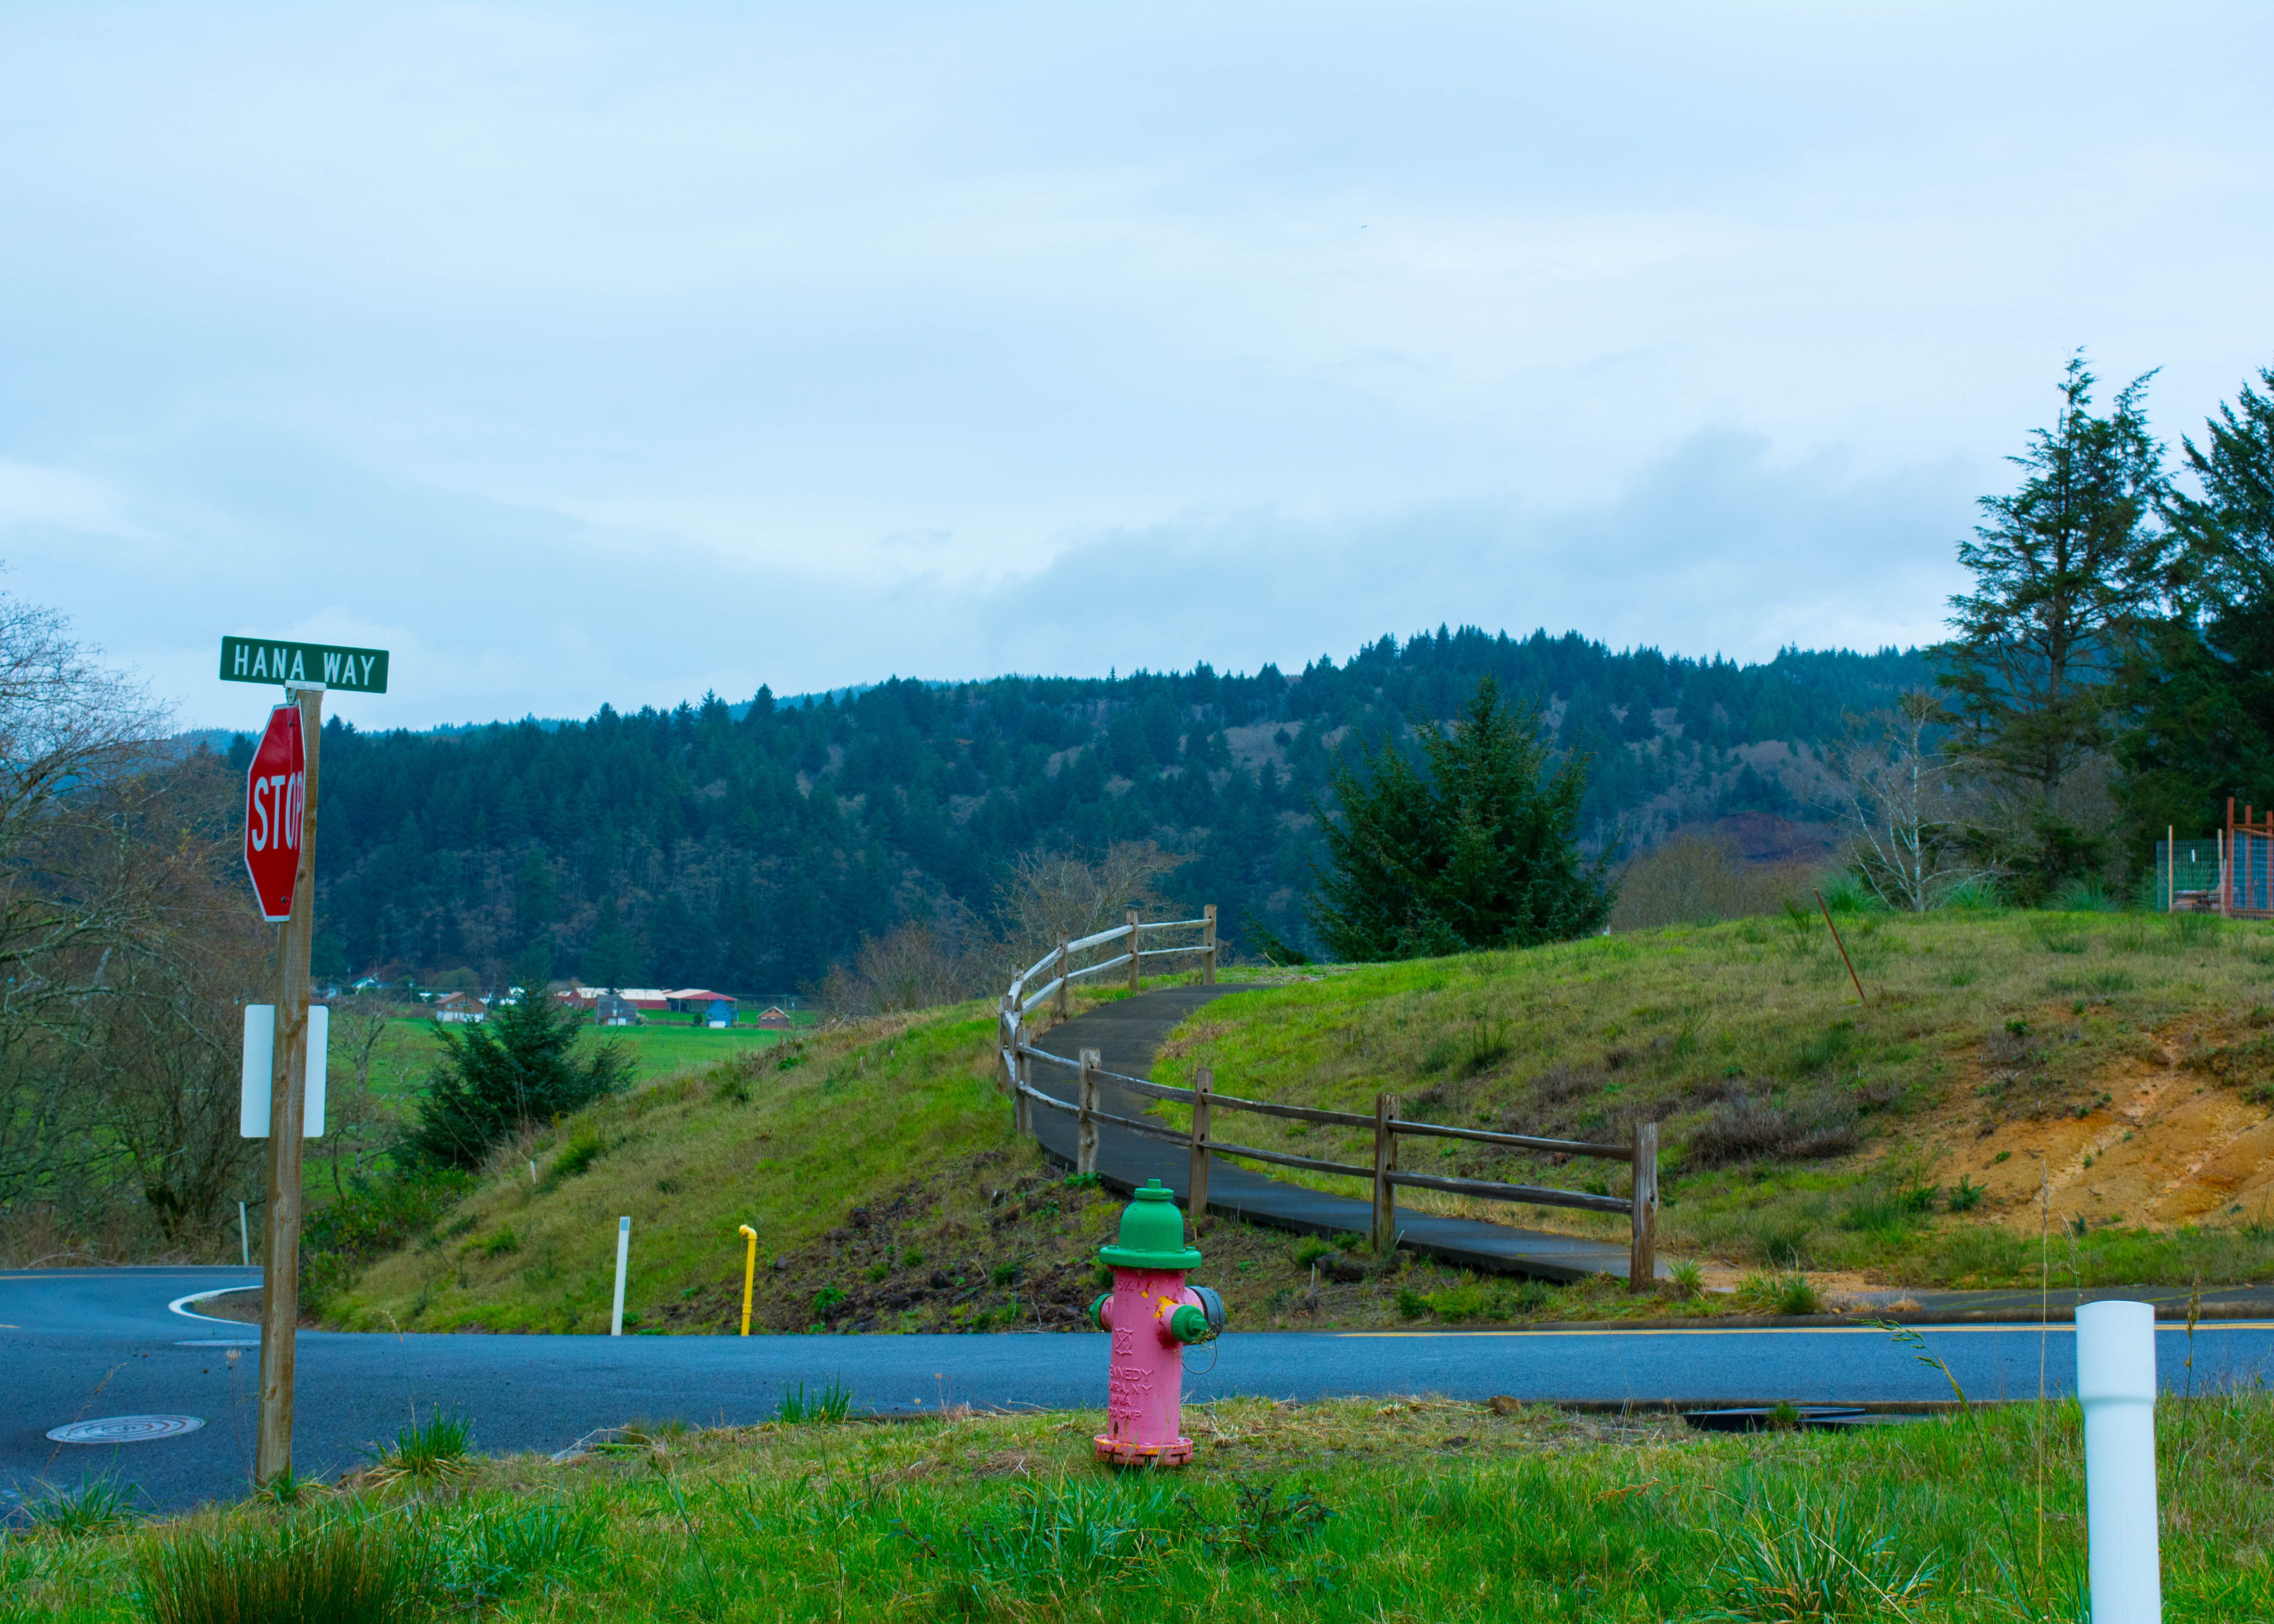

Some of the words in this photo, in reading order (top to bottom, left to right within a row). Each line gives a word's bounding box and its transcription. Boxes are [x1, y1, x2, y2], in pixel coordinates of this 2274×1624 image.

[234, 645, 305, 680] HANA
[324, 652, 375, 685] WAY
[252, 771, 303, 852] STOP
[1110, 1364, 1156, 1381] ENNEDY
